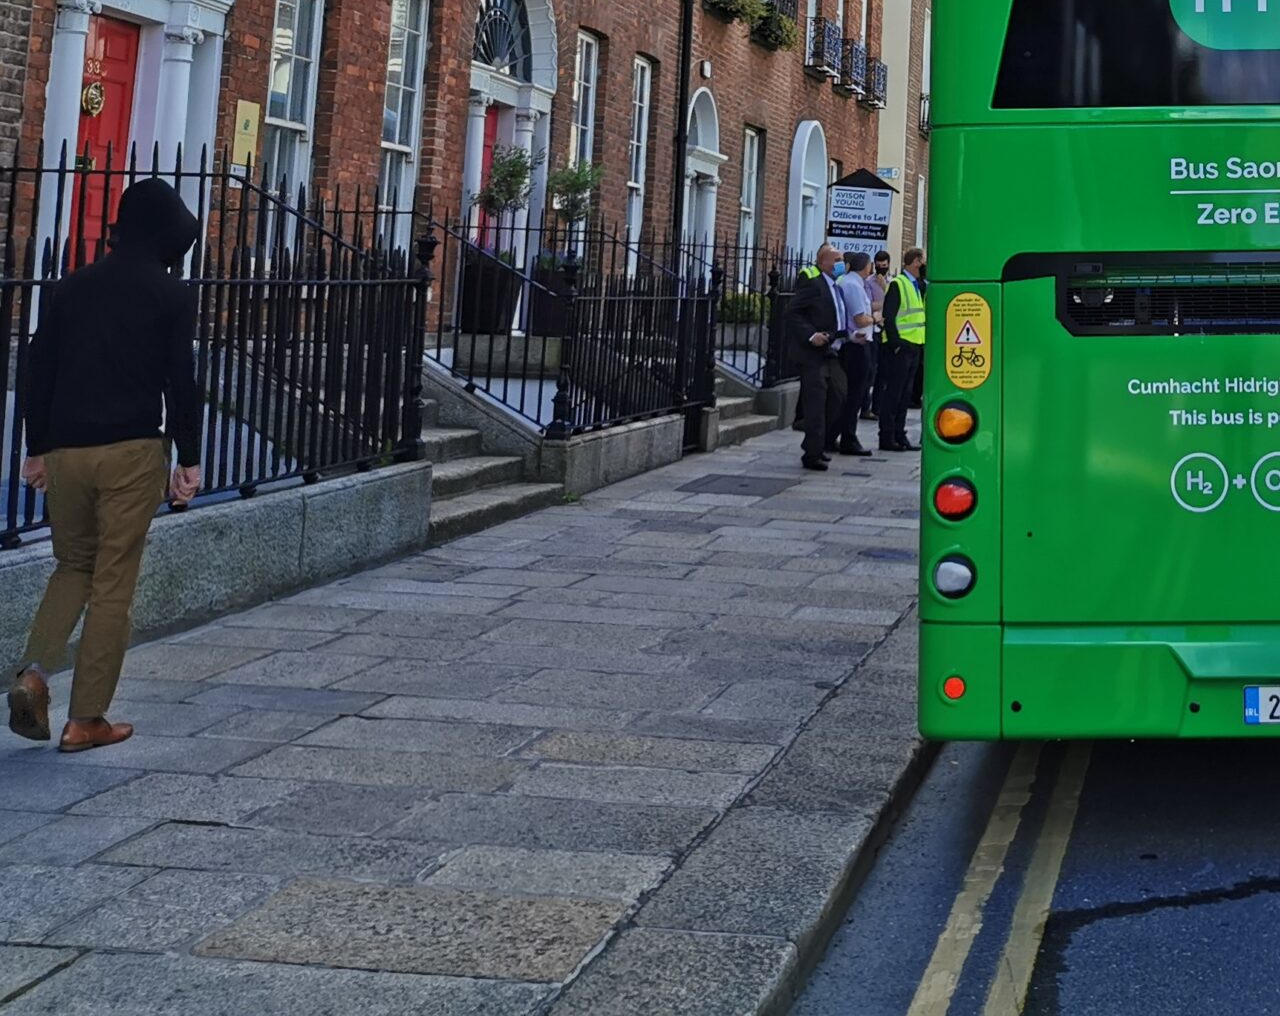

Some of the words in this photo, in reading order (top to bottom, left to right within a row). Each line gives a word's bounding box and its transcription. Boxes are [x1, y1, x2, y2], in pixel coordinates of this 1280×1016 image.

[1170, 157, 1219, 180] Bus
[835, 199, 864, 207] YOUNG
[832, 210, 861, 221] Offices
[874, 213, 886, 222] Let
[1197, 203, 1258, 225] Zero
[843, 242, 860, 252] 676
[1127, 377, 1220, 395] Cumhacht
[1168, 409, 1207, 426] This
[1211, 409, 1245, 425] bus
[1248, 408, 1263, 425] is
[1245, 708, 1259, 716] IRL
